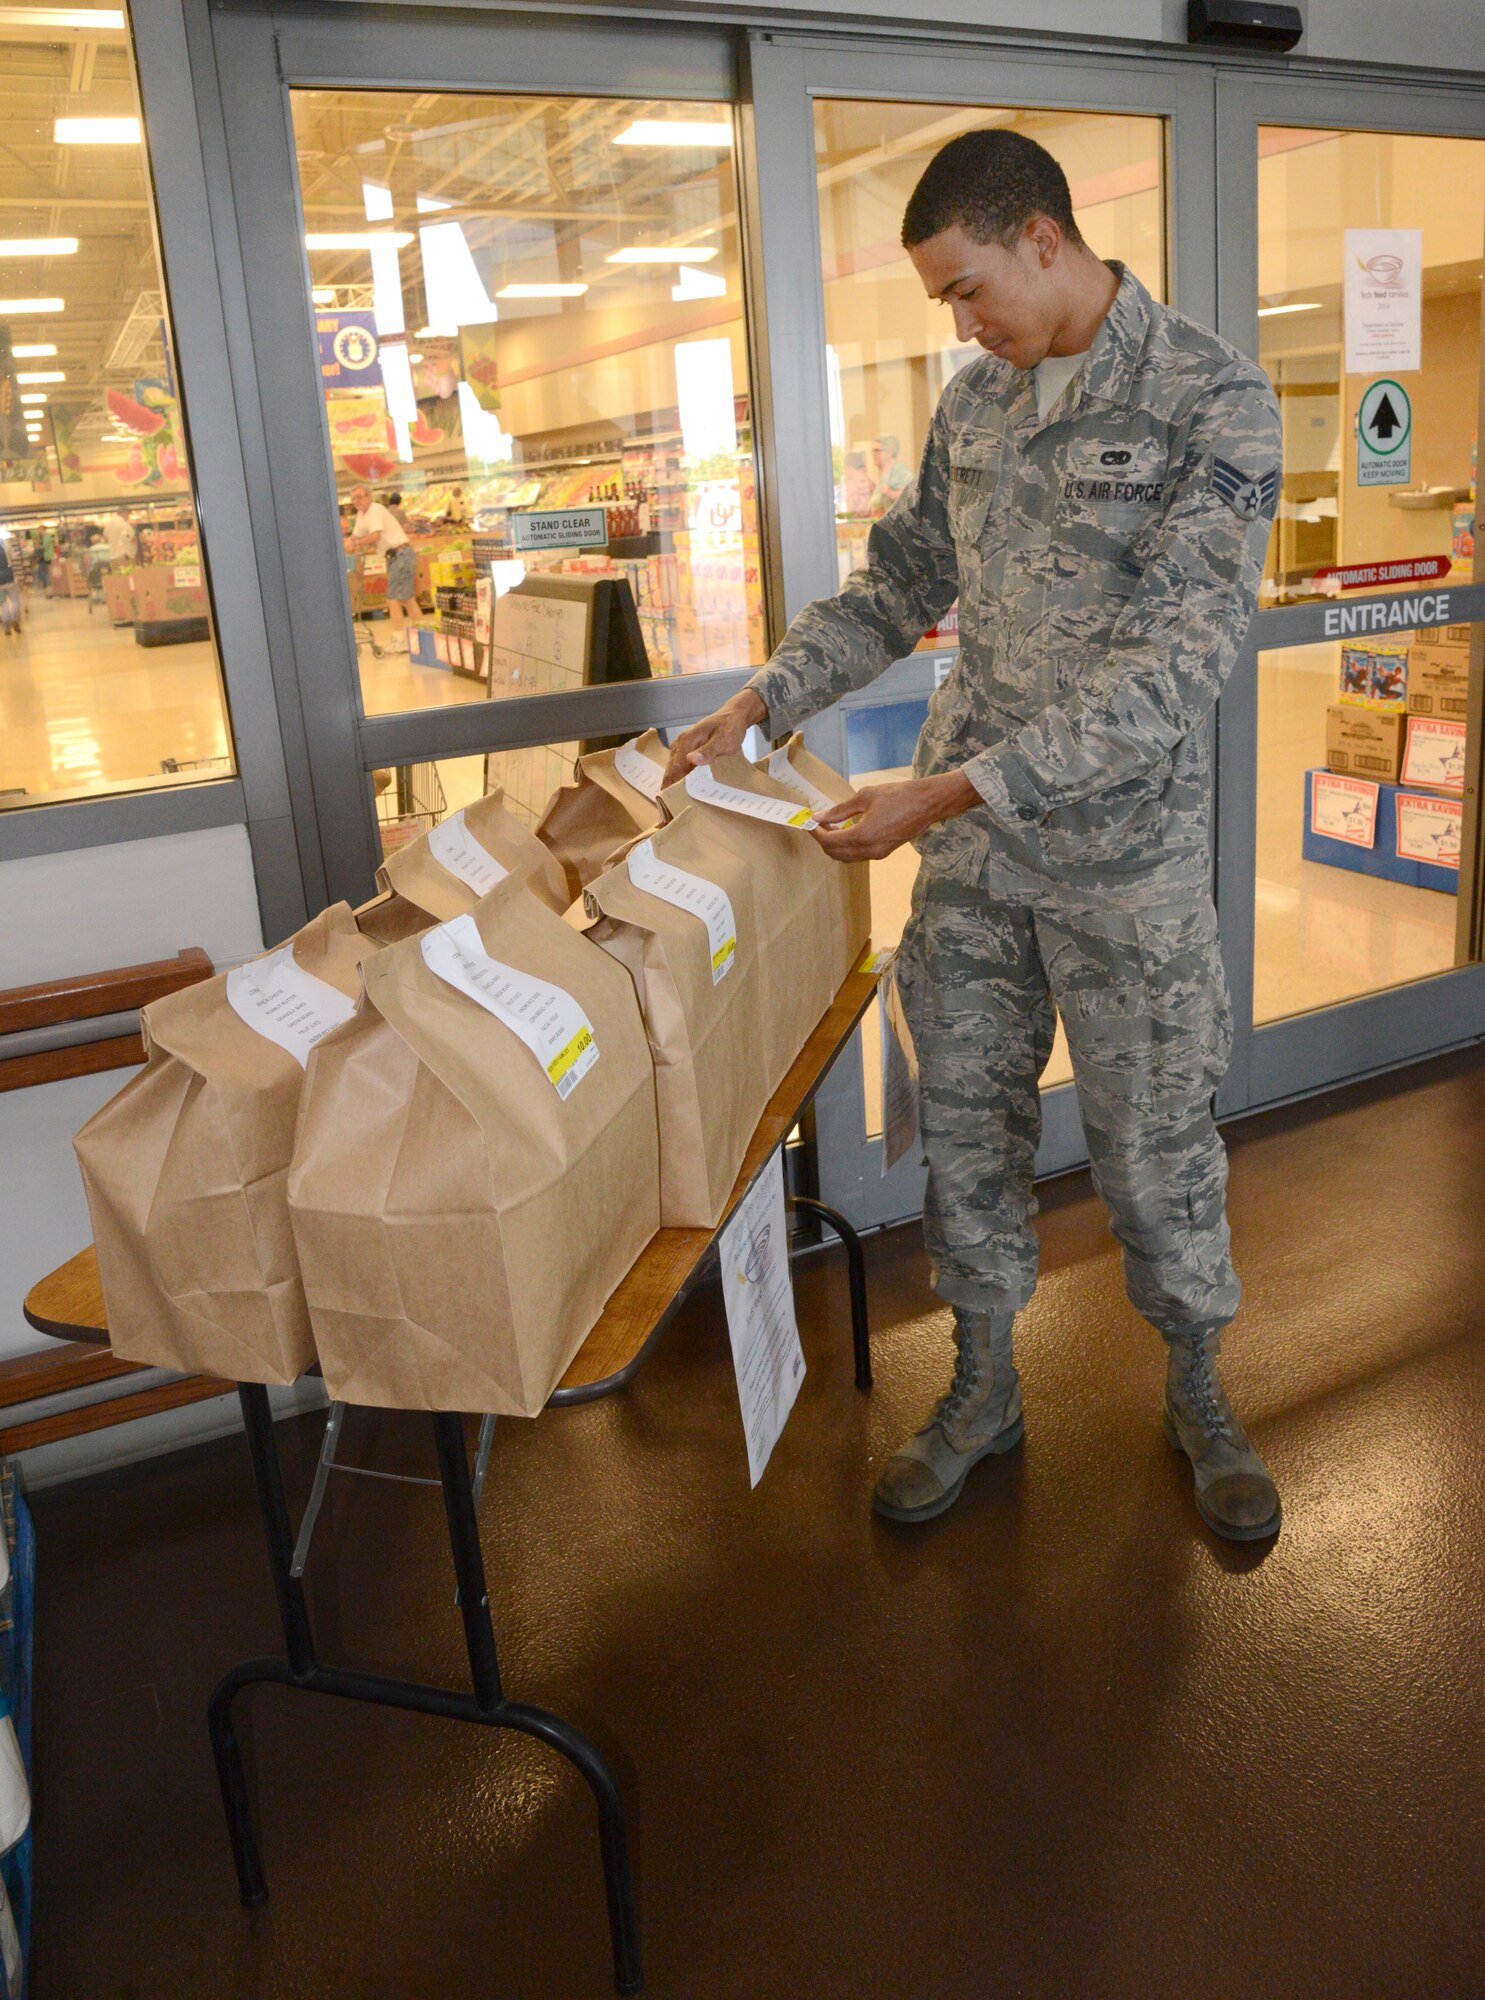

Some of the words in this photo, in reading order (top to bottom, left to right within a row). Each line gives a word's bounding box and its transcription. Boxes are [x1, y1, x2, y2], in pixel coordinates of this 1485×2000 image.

[1361, 461, 1391, 469] AUTOMATIC
[1392, 459, 1407, 467] DOOR
[1362, 470, 1379, 479] KEEP
[1380, 468, 1405, 477] MOVING
[1064, 480, 1085, 499] U.S.
[1088, 481, 1111, 499] AIR
[1114, 482, 1164, 501] FORCE
[530, 520, 560, 531] STAND
[562, 518, 591, 529] CLEAR
[521, 532, 557, 541] AUTOMATIC
[559, 531, 582, 539] SLIDING
[584, 529, 601, 537] DOOR
[1327, 567, 1378, 585] AUTOMATIC
[1378, 563, 1413, 580] SLIDING
[1414, 561, 1438, 576] DOOR
[1325, 594, 1450, 636] ENTRANCE
